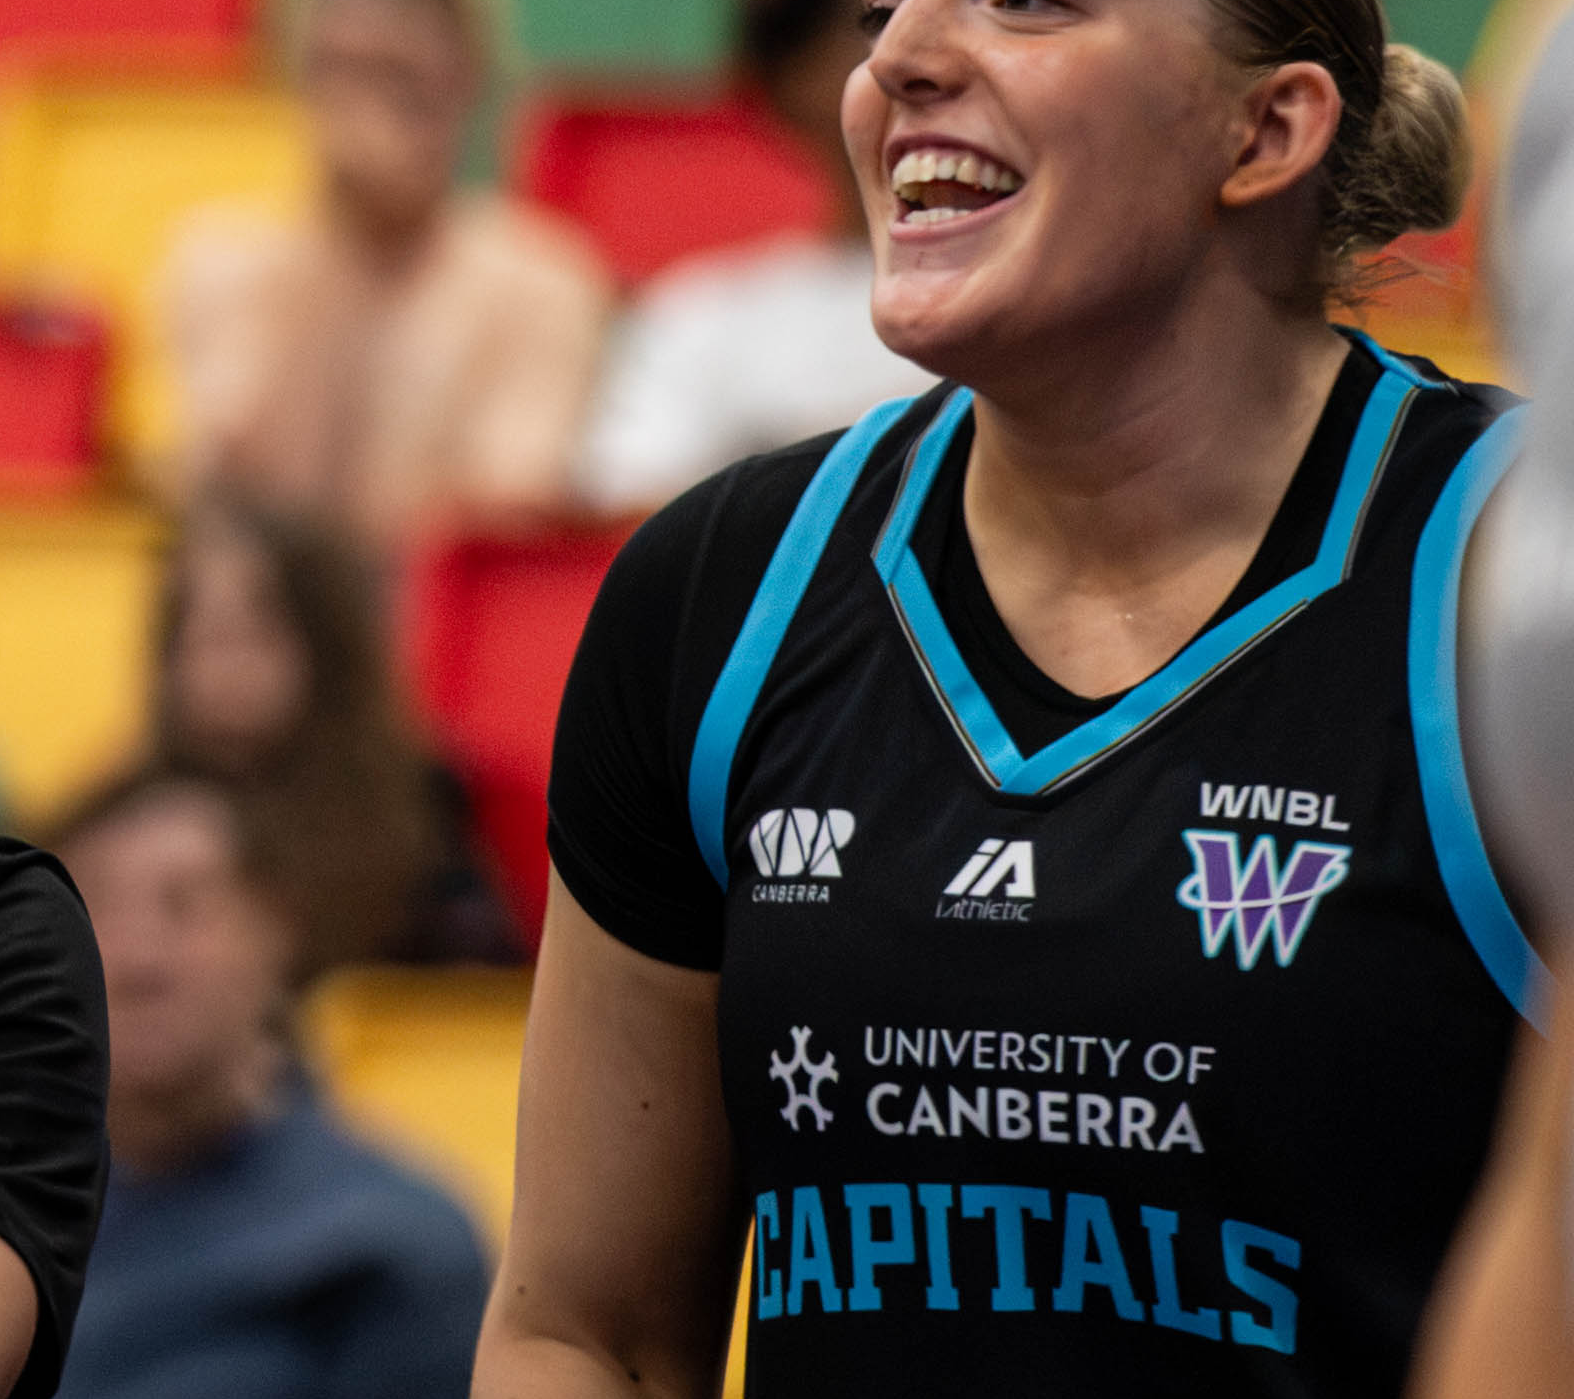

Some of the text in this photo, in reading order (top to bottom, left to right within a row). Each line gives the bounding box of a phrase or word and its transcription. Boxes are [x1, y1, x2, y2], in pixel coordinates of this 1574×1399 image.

[1201, 782, 1350, 831] WNBL
[752, 884, 830, 903] CANBERRA
[864, 1026, 1217, 1085] UNIVERSITY OF
[867, 1082, 1205, 1154] CANBERRA
[756, 1180, 1302, 1356] CAPITALS
